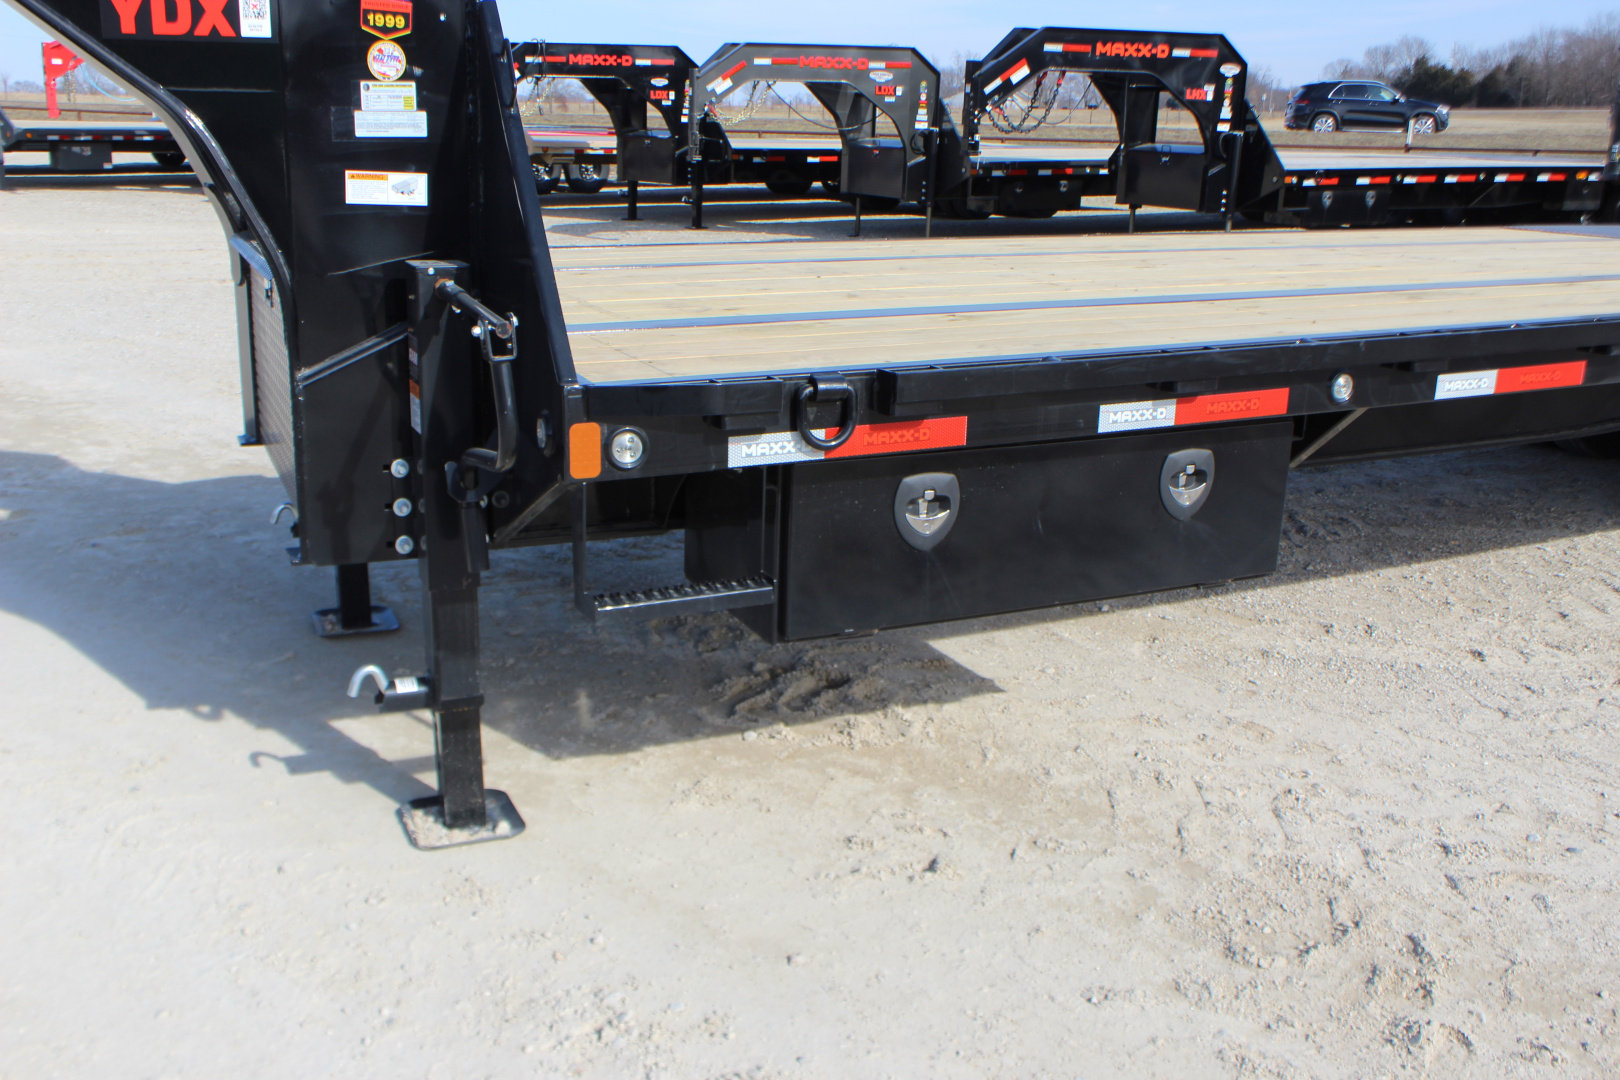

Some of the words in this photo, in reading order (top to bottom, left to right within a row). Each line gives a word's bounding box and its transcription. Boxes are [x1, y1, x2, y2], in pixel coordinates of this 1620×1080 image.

[110, 0, 237, 37] YDX
[367, 11, 405, 29] 1999
[1095, 41, 1170, 58] MAXX-D
[568, 53, 633, 67] MAXX-D
[799, 55, 869, 70] MAXX-D
[650, 90, 668, 99] LDX
[875, 85, 895, 95] LDX
[1185, 87, 1208, 100] LHX
[1444, 377, 1489, 392] MAXX-D
[1519, 370, 1562, 385] MAXX-D
[1206, 399, 1260, 415] MAXX-D
[1108, 407, 1167, 424] MAXX-D
[863, 428, 930, 446] MAXX-D
